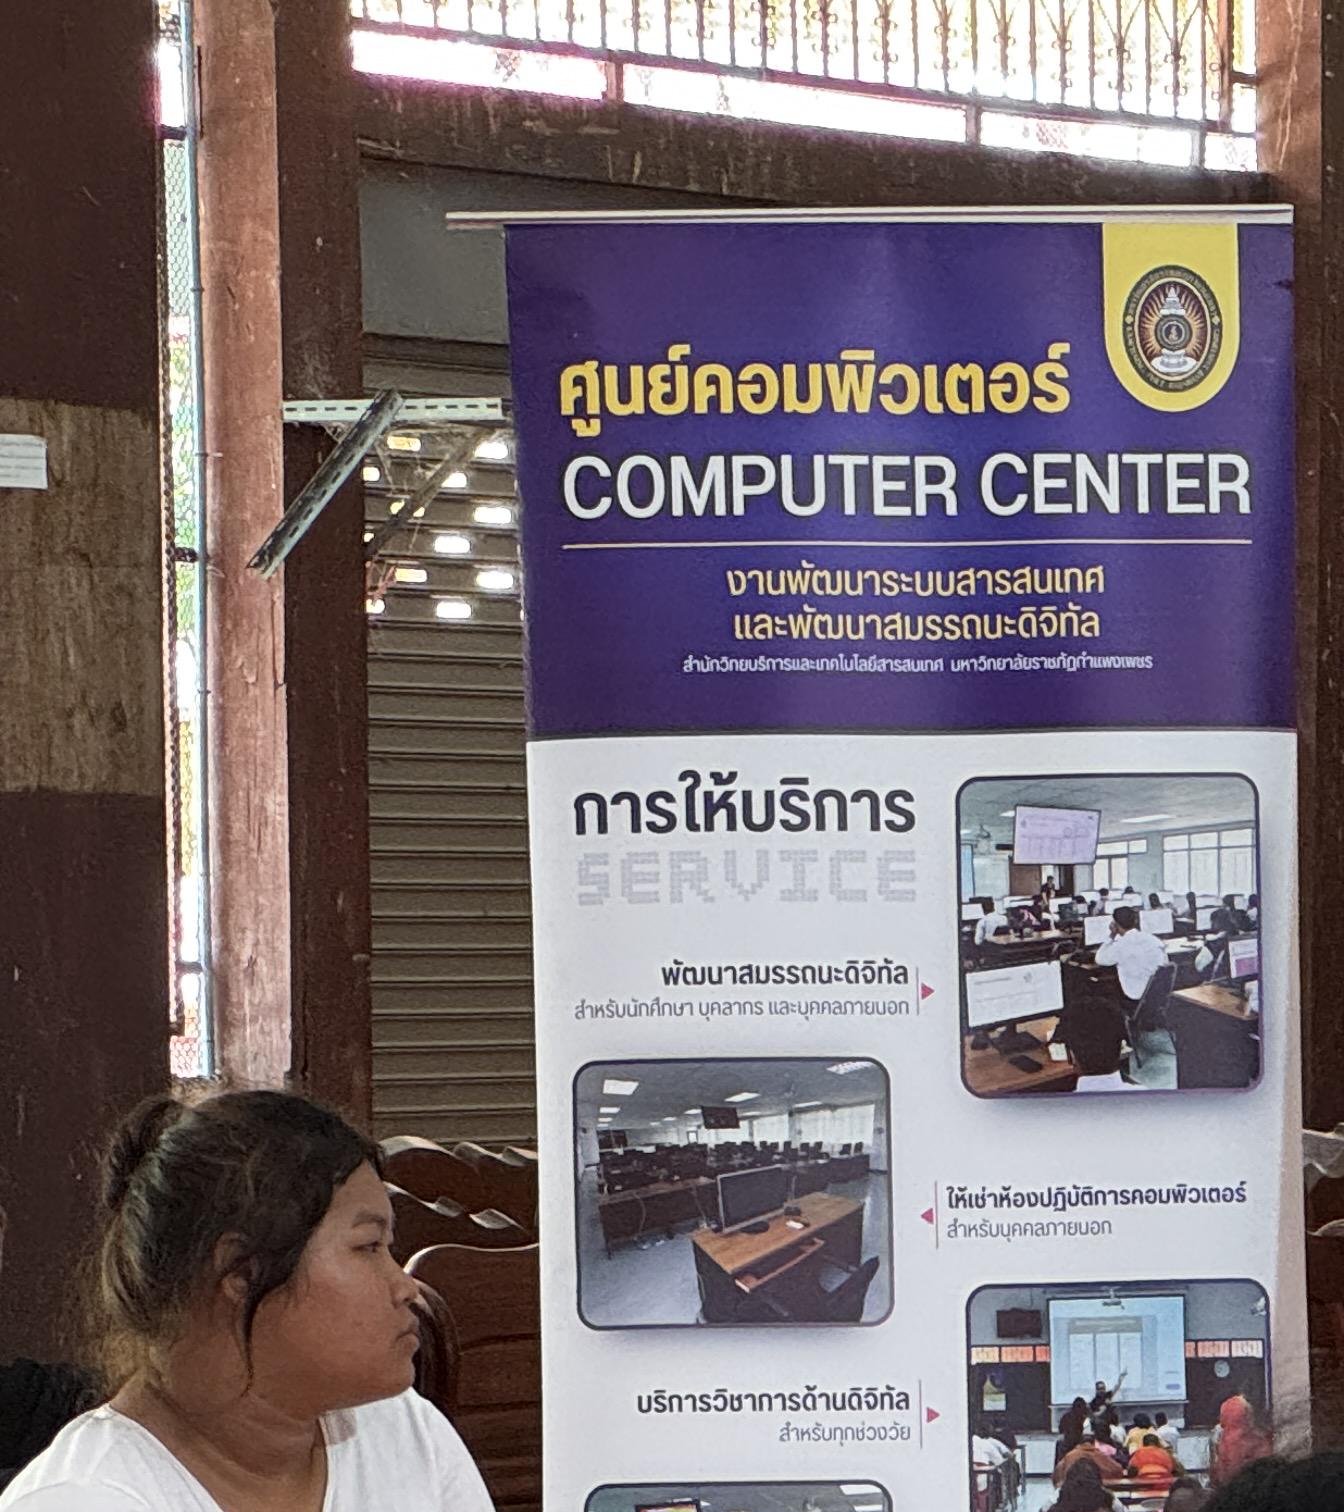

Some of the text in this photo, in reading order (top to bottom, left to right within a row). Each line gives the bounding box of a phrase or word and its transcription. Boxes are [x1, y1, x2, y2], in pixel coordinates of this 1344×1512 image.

[559, 341, 1072, 437] ศูนย์คอมพิวเตอร์
[562, 452, 1252, 519] COMPUTER CENTER
[726, 560, 1105, 597] งานพัฒนาระบบสารสนเทศ
[734, 602, 1101, 641] และพัฒนาสมรรถนะดิจิทัล
[573, 769, 917, 835] การให้บริการ
[577, 849, 917, 905] SERVICE
[661, 959, 909, 986] พัฒนาสมรรถนะดิจิทัล
[946, 1181, 1247, 1212] ให้เช่าห้องปฏิบัติการคอมพิวเตอร์
[947, 1217, 1113, 1243] สำหรับบุคคลภายนอก
[637, 1385, 911, 1414] บริการวิชาการด้านดิจิทัล
[778, 1421, 911, 1447] สำหรับทุกช่วงวัย
